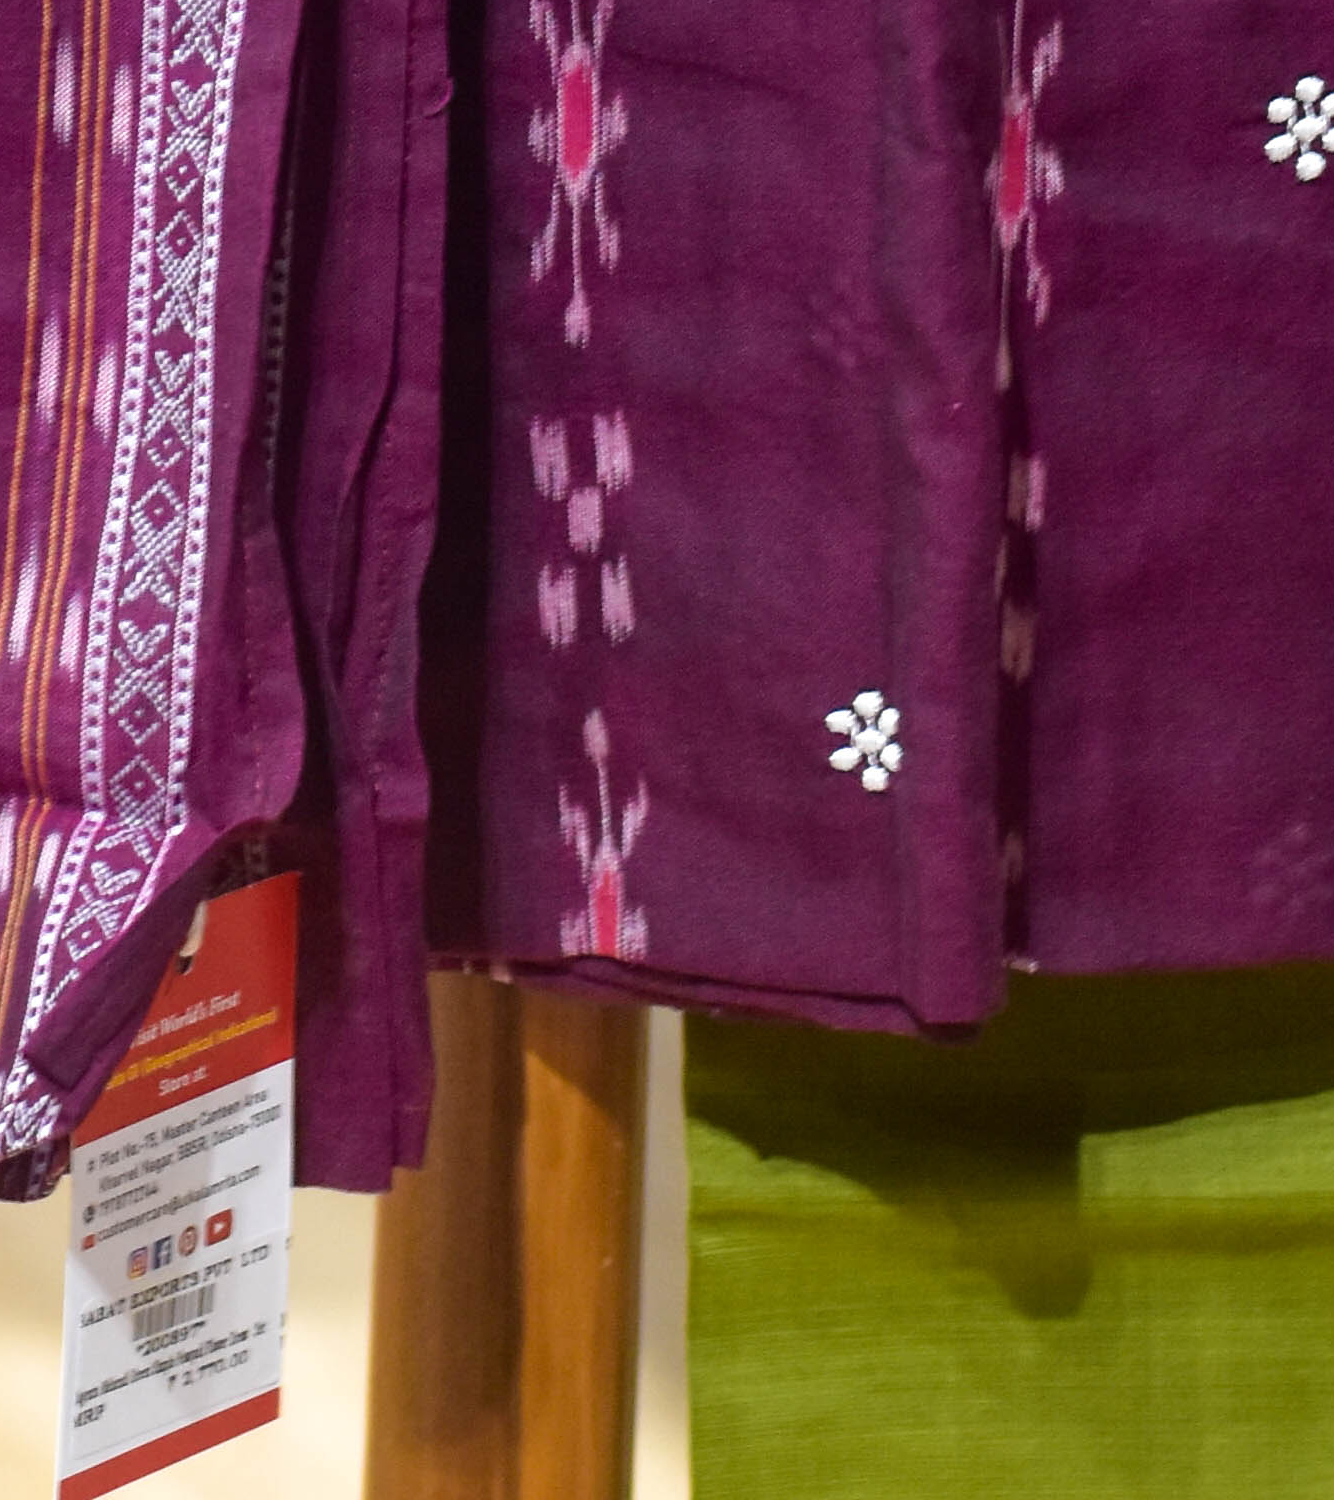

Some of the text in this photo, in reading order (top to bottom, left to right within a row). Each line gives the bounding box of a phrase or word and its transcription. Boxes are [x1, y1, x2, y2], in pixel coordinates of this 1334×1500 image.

[130, 1026, 157, 1049] isit
[210, 990, 242, 1017] First
[158, 1073, 189, 1097] Store
[100, 1150, 120, 1167] Plot
[161, 1119, 198, 1140] Master
[199, 1100, 240, 1127] Canteen
[244, 1090, 268, 1107] Area
[130, 1271, 199, 1311] EXPORTS
[203, 1257, 232, 1283] PVT
[240, 1244, 269, 1268] LTD
